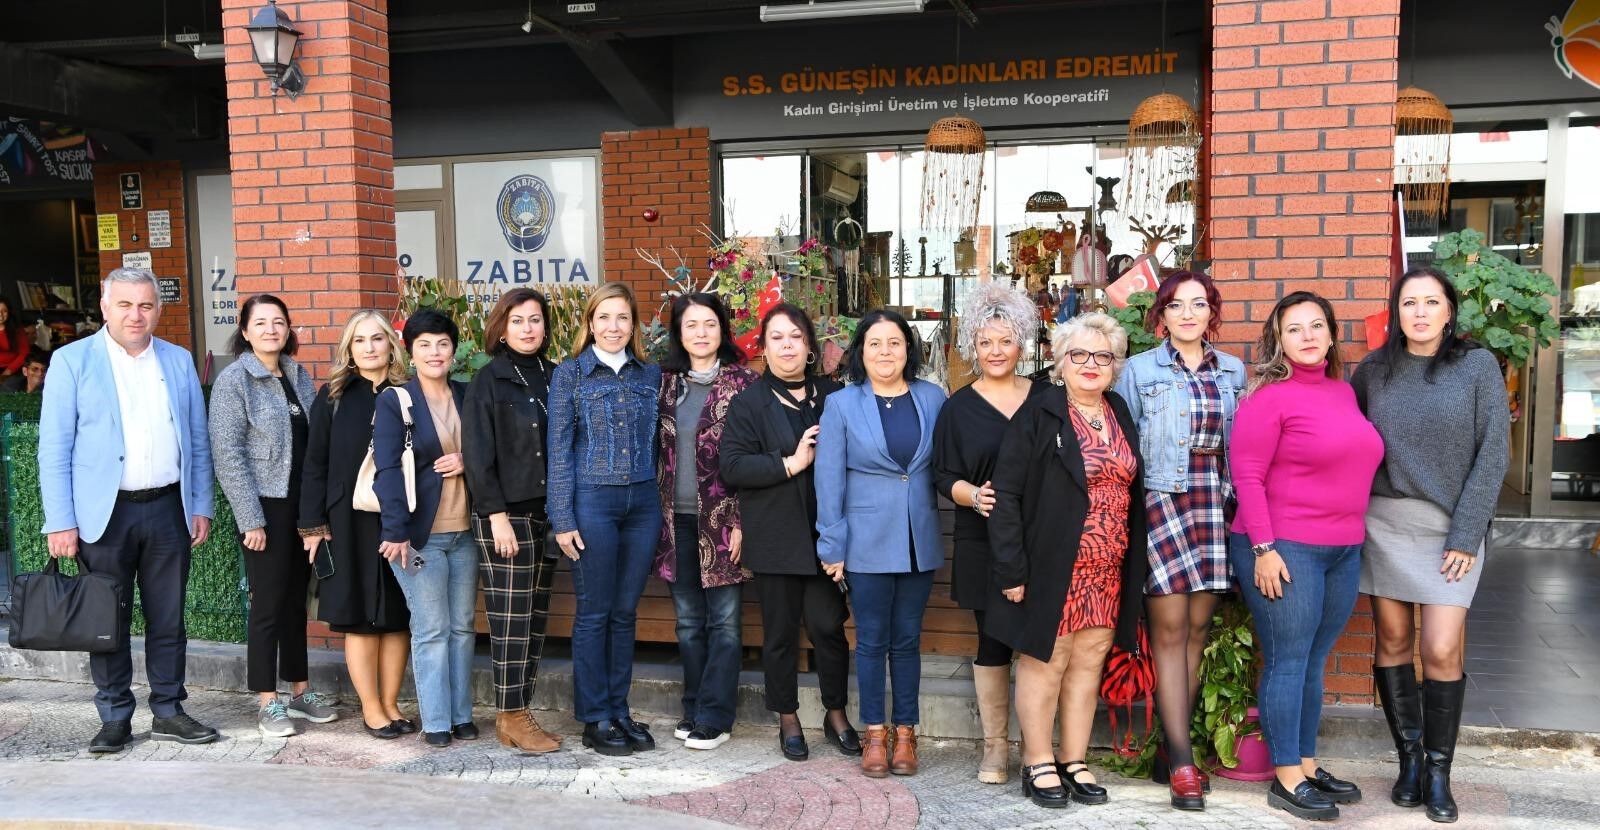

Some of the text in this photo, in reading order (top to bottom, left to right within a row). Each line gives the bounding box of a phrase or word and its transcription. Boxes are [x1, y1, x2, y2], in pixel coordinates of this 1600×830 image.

[722, 48, 1178, 96] S.S. GÜNEŞİN KADINLARI EDREMİT
[783, 89, 1109, 116] Kadın Girişimi Üretim ve İşletme Kooperatifi
[54, 149, 87, 161] KASAP
[58, 163, 94, 180] SUCUK
[467, 258, 590, 284] ZABITA
